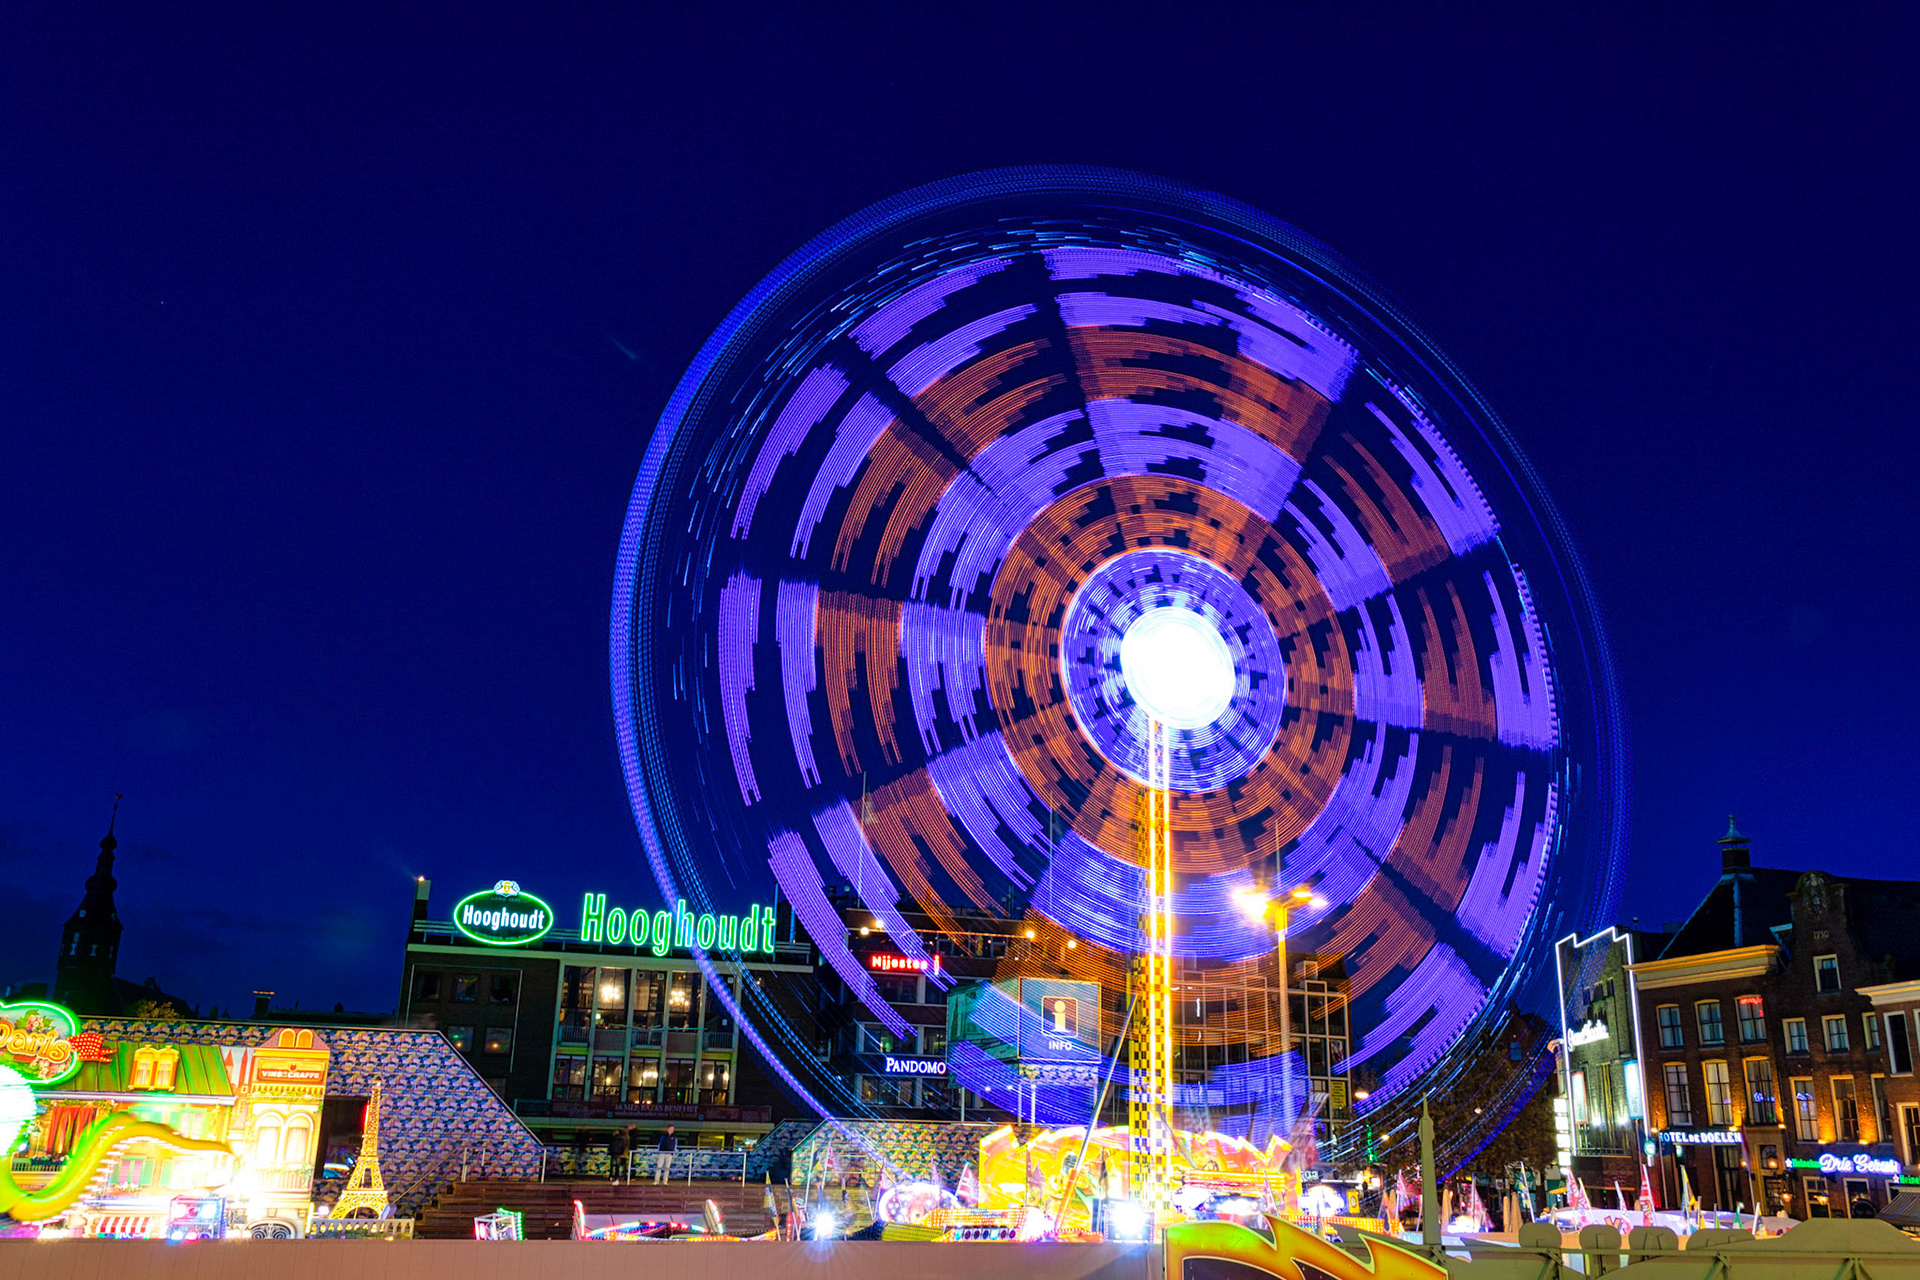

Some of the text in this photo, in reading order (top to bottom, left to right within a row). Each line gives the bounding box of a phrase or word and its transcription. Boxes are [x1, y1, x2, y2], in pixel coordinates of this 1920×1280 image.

[462, 904, 545, 931] Hooghoudt
[580, 893, 776, 957] Hooghoudt
[1048, 1040, 1073, 1051] INFO
[885, 1057, 947, 1074] PANDOMO
[1700, 1131, 1742, 1143] DOELEN
[1900, 1174, 1920, 1185] Heine
